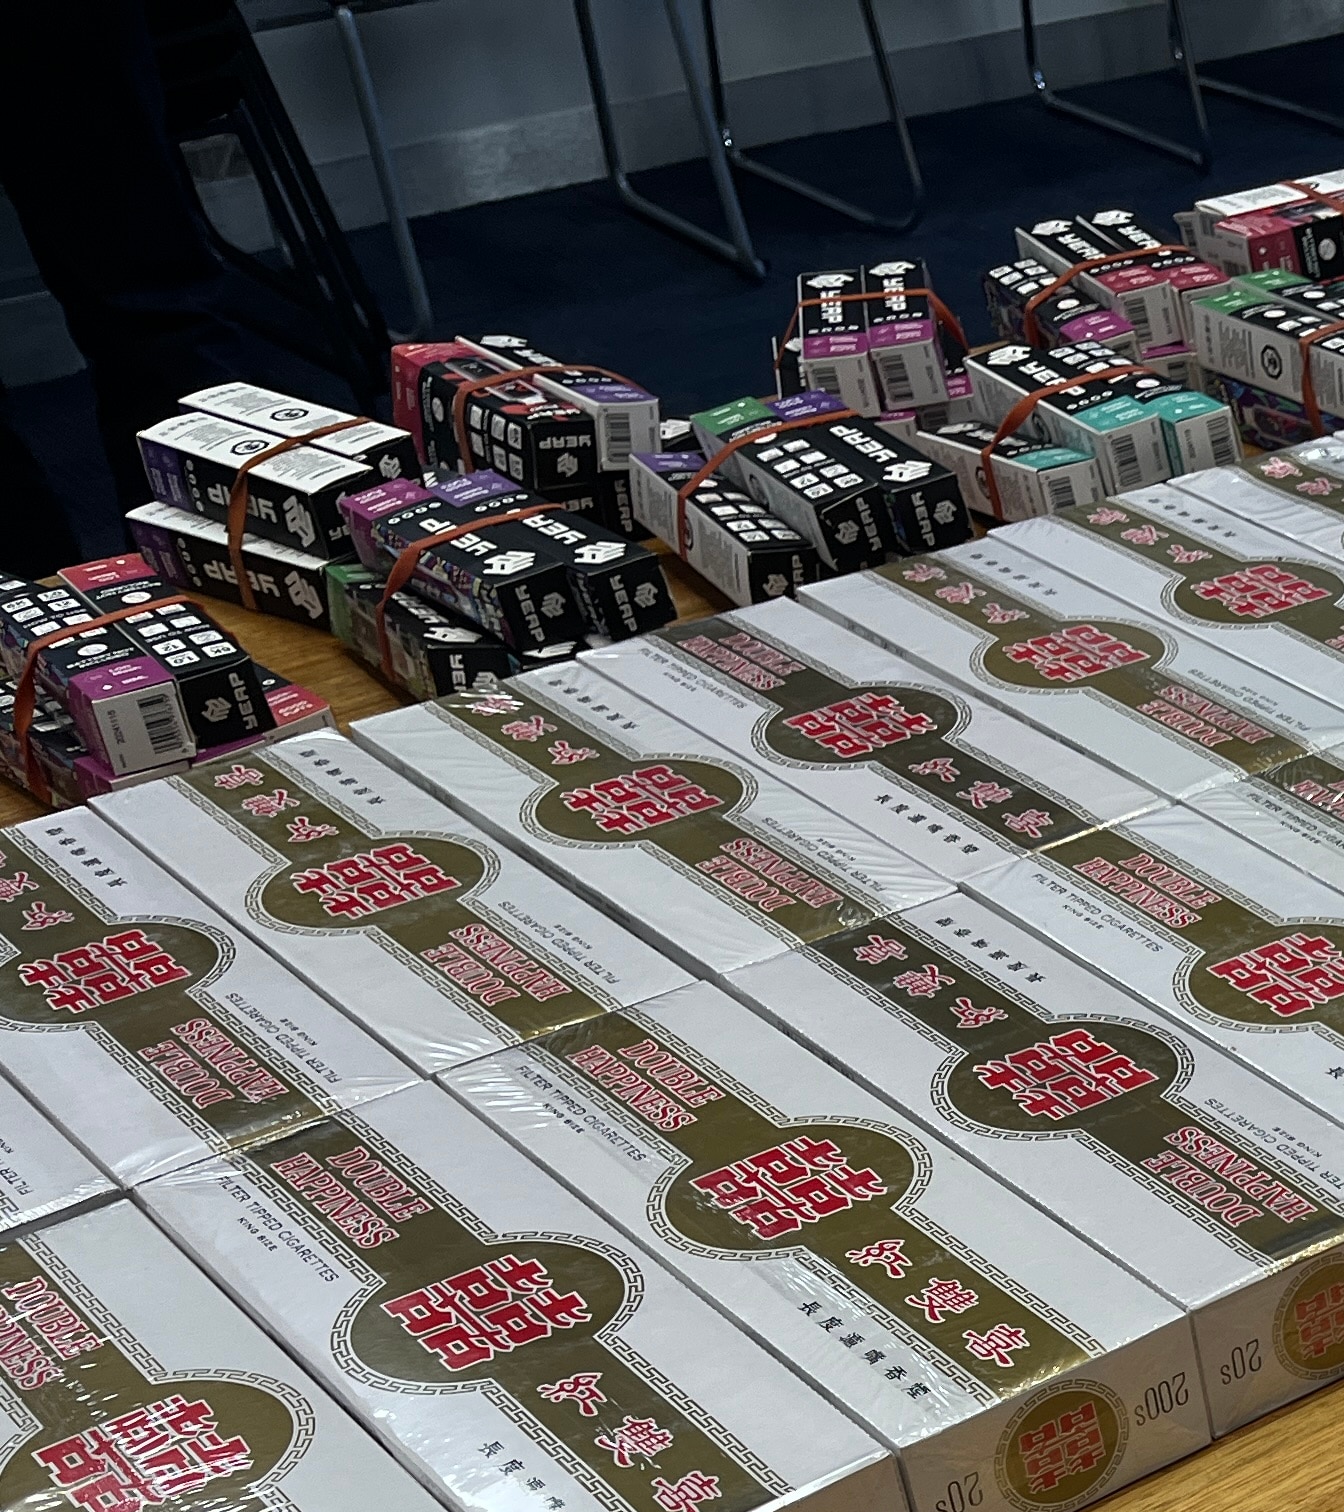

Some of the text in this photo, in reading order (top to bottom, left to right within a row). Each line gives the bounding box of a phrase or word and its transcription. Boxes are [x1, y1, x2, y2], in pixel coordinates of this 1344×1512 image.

[697, 857, 794, 913] DOUBLE
[721, 838, 841, 909] HAPPINESS
[1073, 857, 1202, 928] HAPPINESS
[1119, 853, 1222, 910] DOUBLE
[1032, 873, 1164, 953] FILTER TIPPED CIGARETTES
[420, 942, 521, 1006] DOUBLE
[449, 924, 572, 1003] HAPPINESS
[137, 1040, 235, 1108] DOUBLE
[171, 1018, 289, 1103] HAPPINESS
[565, 1045, 697, 1132] HAPPINESS
[619, 1039, 726, 1108] DOUBLE
[515, 1065, 647, 1162] FILTER TIPPED CIGARETTES
[1204, 1098, 1277, 1145] CIGARETTES
[327, 1146, 433, 1222] DOUBLE
[1140, 1150, 1263, 1227] DOUBLE
[1163, 1126, 1317, 1224] HAPPINESS
[1276, 1144, 1323, 1173] TIPPED
[216, 1176, 340, 1283] FILTER TIPPED CIGARETTES
[271, 1152, 400, 1249] HAPPINESS
[1, 1276, 102, 1360] DOUBLE
[1220, 1338, 1262, 1386] 20s
[1134, 1372, 1189, 1427] 200s
